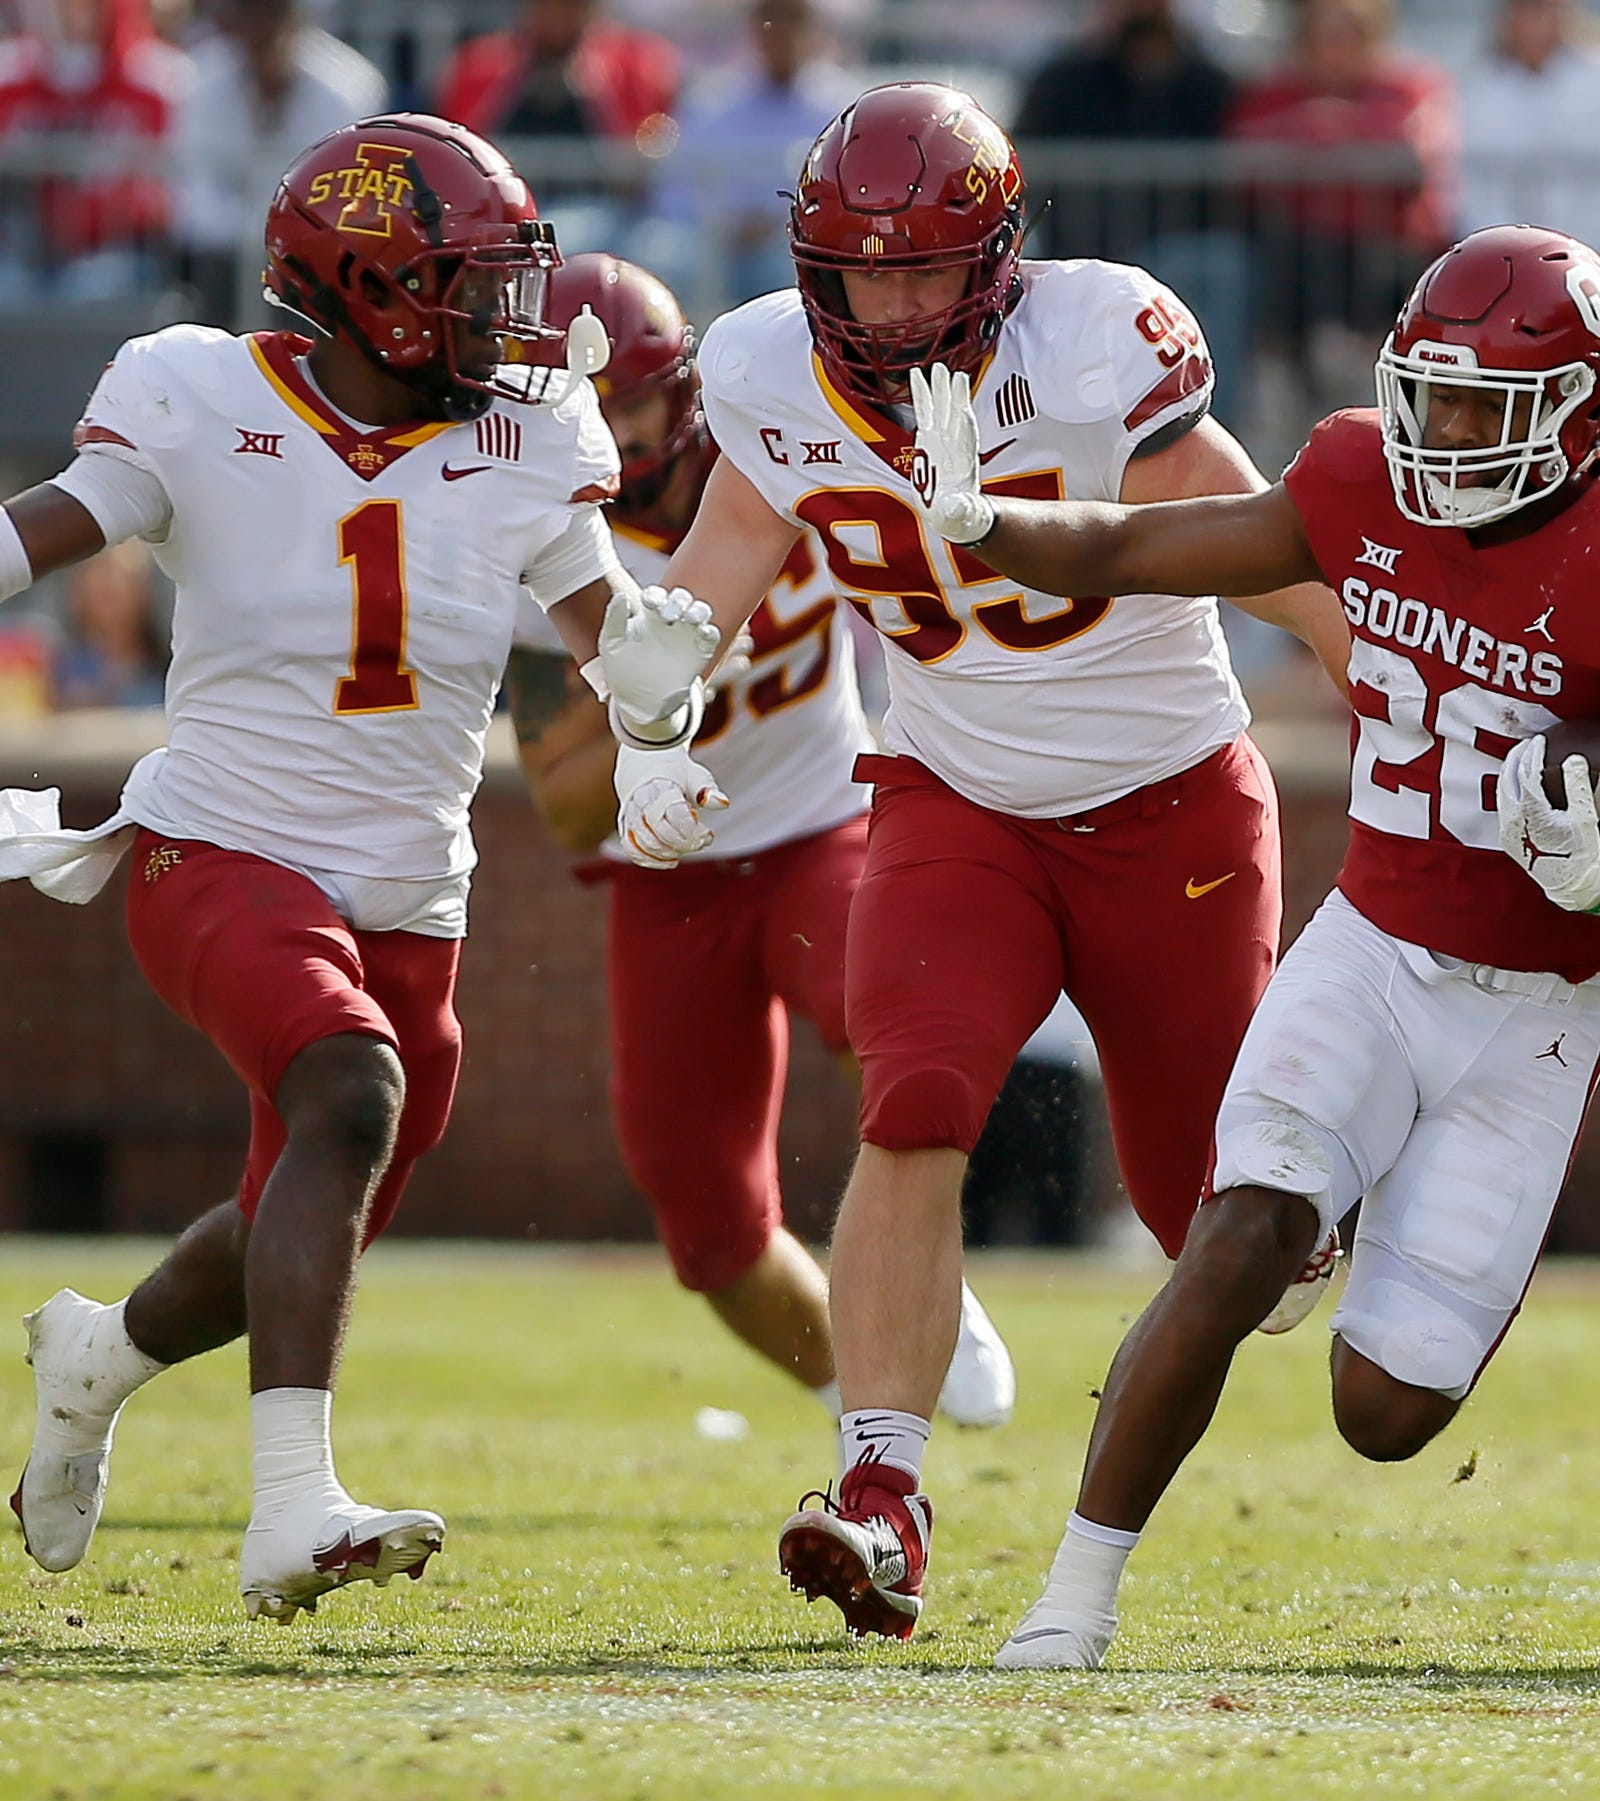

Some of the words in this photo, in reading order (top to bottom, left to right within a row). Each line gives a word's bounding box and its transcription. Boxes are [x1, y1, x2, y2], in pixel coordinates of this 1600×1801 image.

[307, 168, 414, 207] STAT
[234, 428, 285, 459] XII
[760, 428, 790, 466] C
[800, 440, 843, 465] XII
[792, 467, 1115, 665] 95
[1355, 536, 1403, 576] XII
[335, 499, 418, 714] 1
[1342, 576, 1564, 697] SOONERS
[1346, 634, 1565, 853] 26
